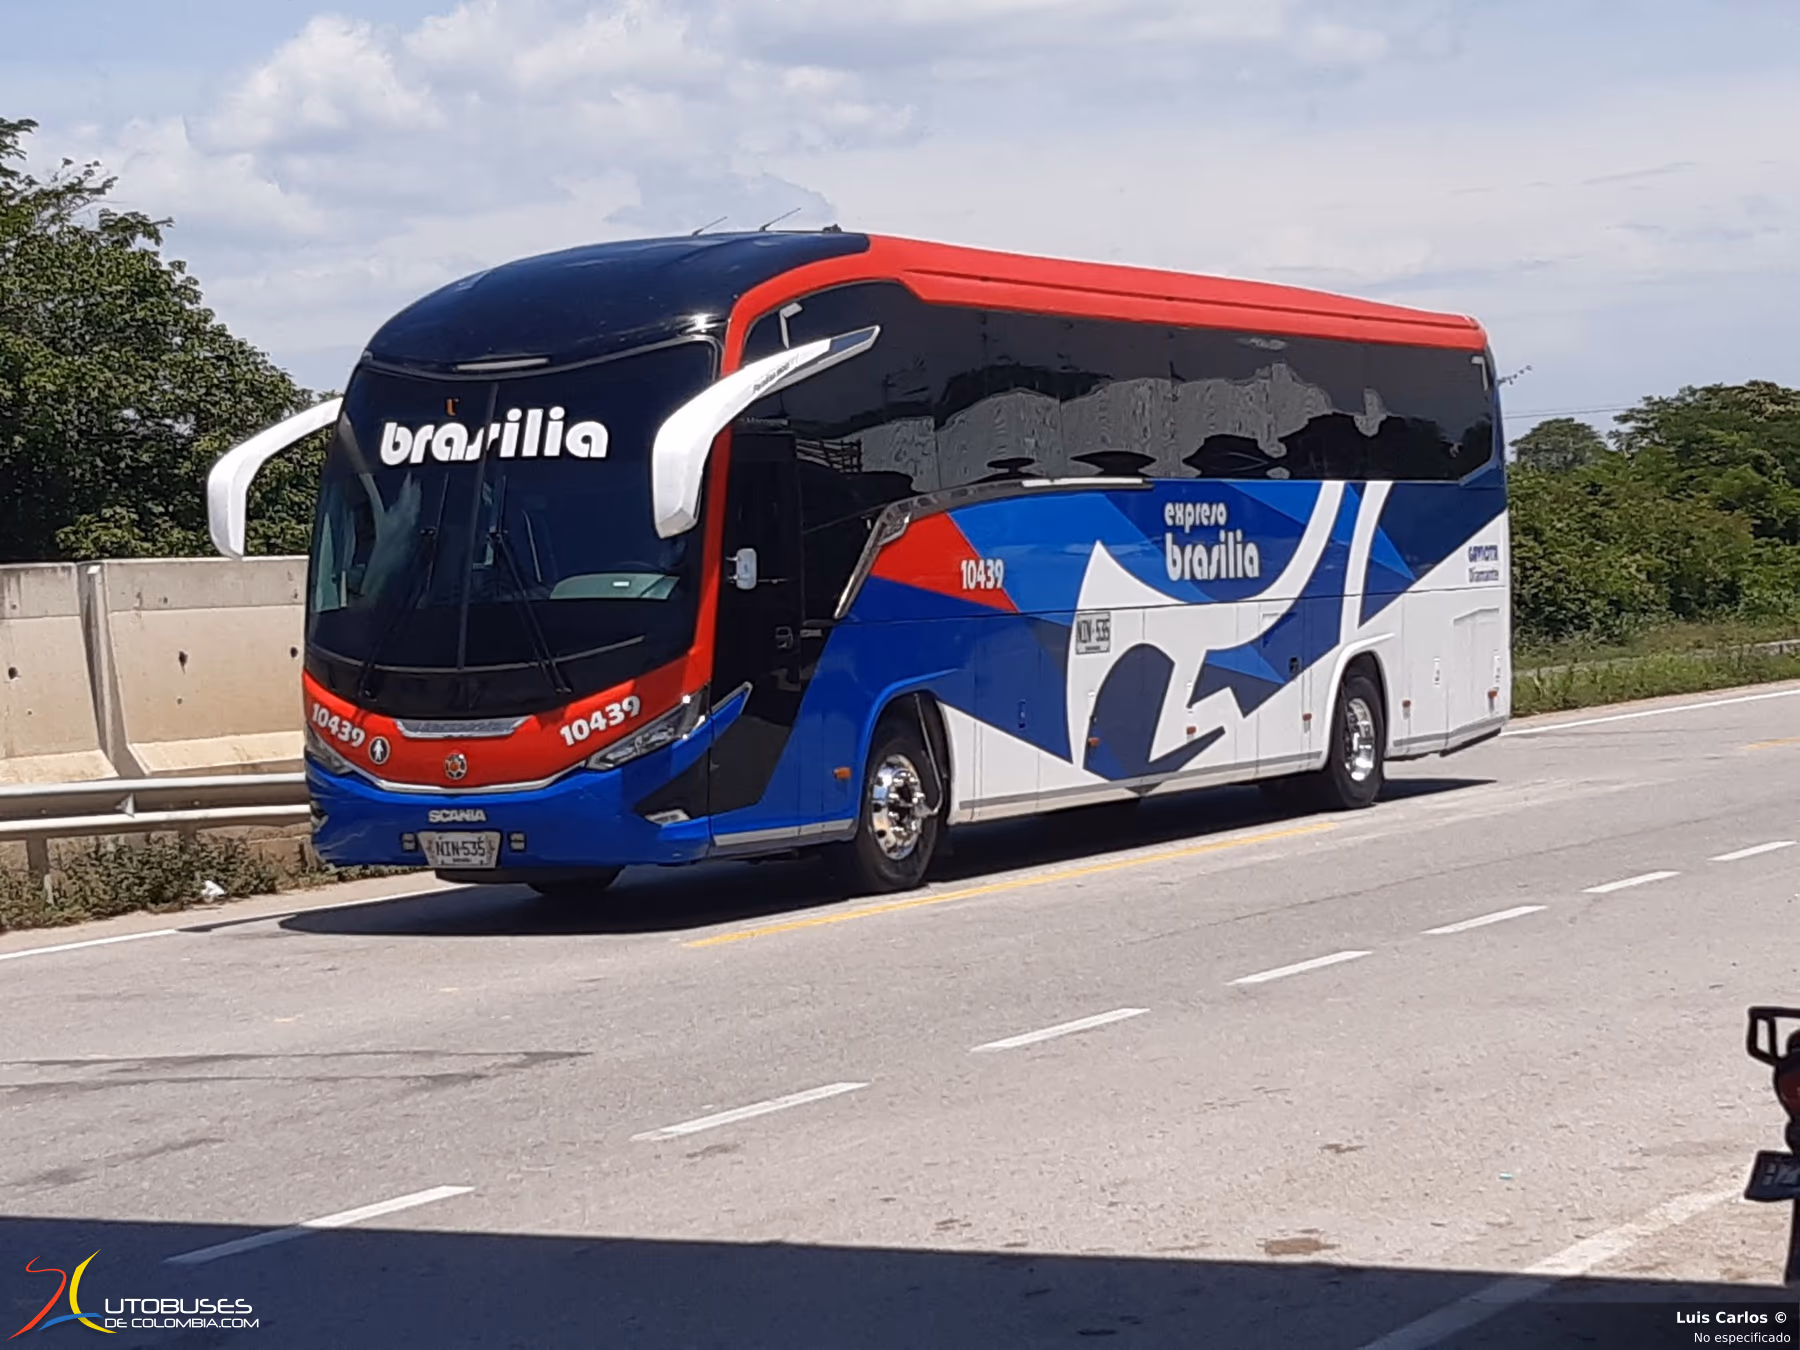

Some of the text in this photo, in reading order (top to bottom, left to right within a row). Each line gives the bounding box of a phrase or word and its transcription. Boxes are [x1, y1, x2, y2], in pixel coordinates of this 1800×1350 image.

[1164, 501, 1229, 533] expreso
[959, 558, 1005, 591] 10439
[1164, 529, 1261, 582] brasilia
[310, 702, 366, 748] 10439
[559, 695, 642, 747] 10439
[428, 809, 487, 823] SCANIA
